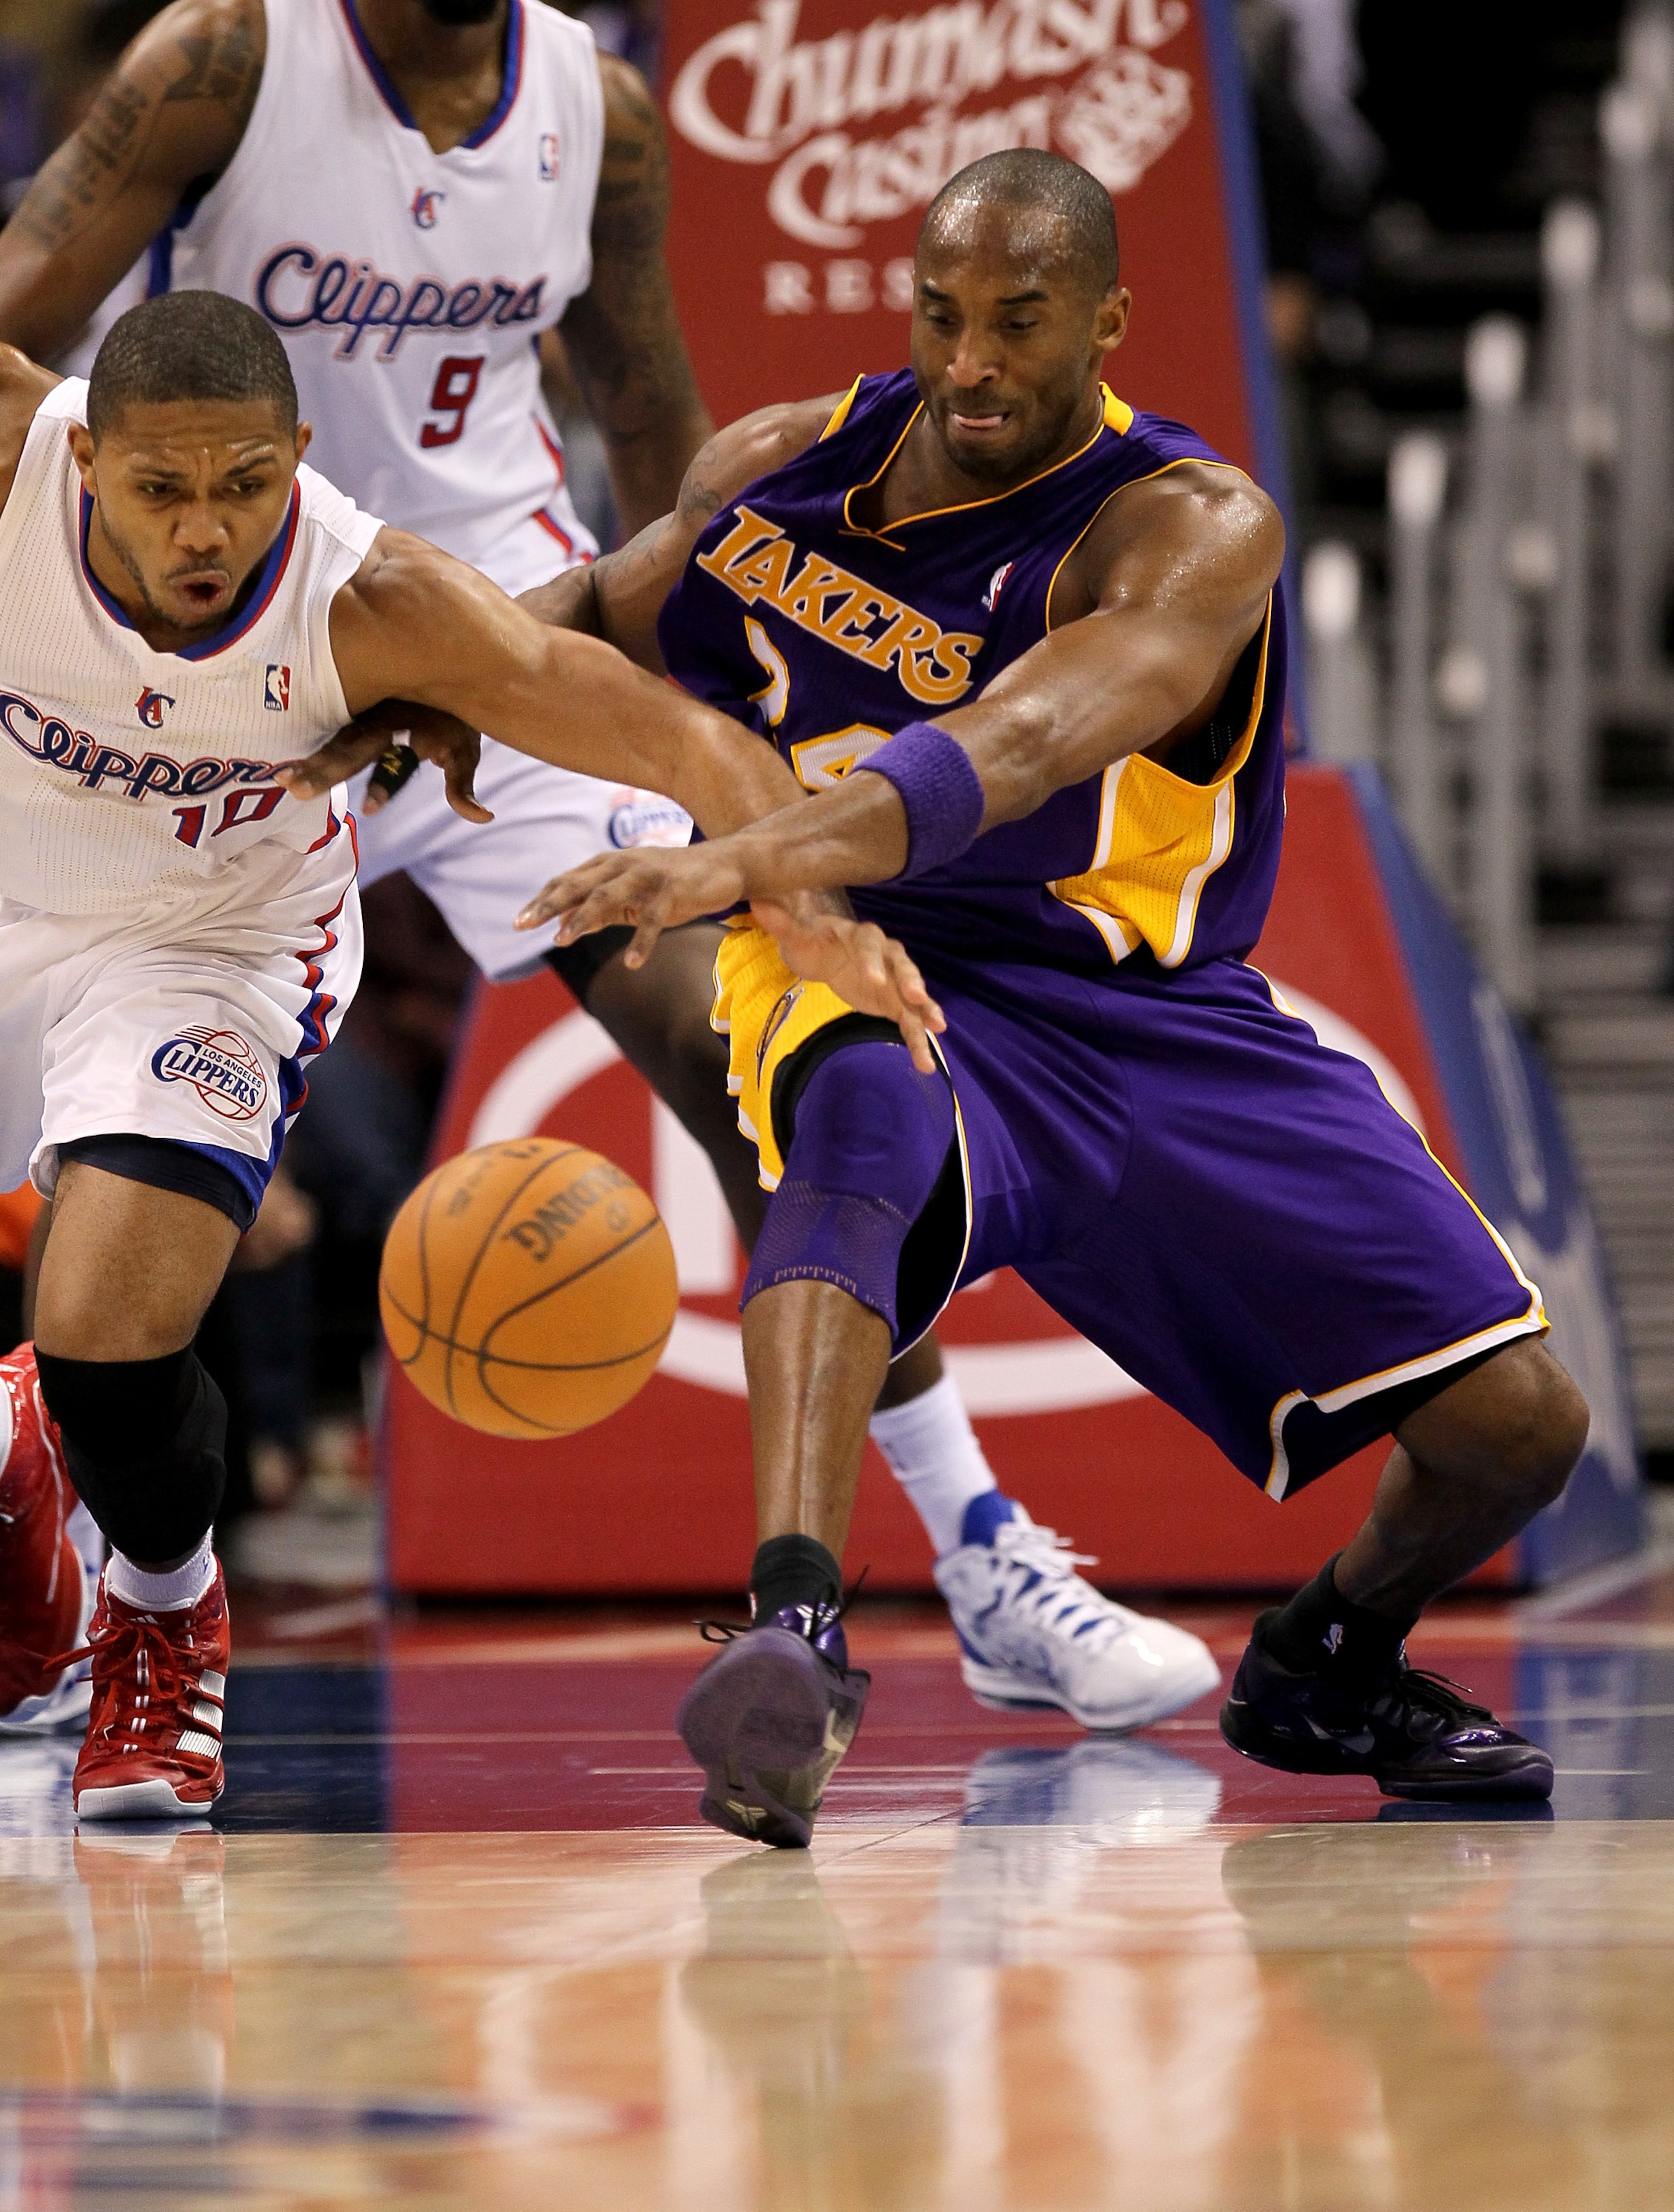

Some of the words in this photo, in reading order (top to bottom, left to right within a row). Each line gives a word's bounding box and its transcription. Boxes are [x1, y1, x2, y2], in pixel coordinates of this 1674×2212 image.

[252, 239, 549, 363] Clippers
[420, 355, 483, 449] 9
[696, 504, 984, 705] LAKERS
[0, 690, 295, 801] Clipper
[172, 786, 287, 849] 10
[151, 1039, 259, 1107] CLIPPERS
[203, 1049, 224, 1063] LOS
[223, 1059, 262, 1088] ANGELES
